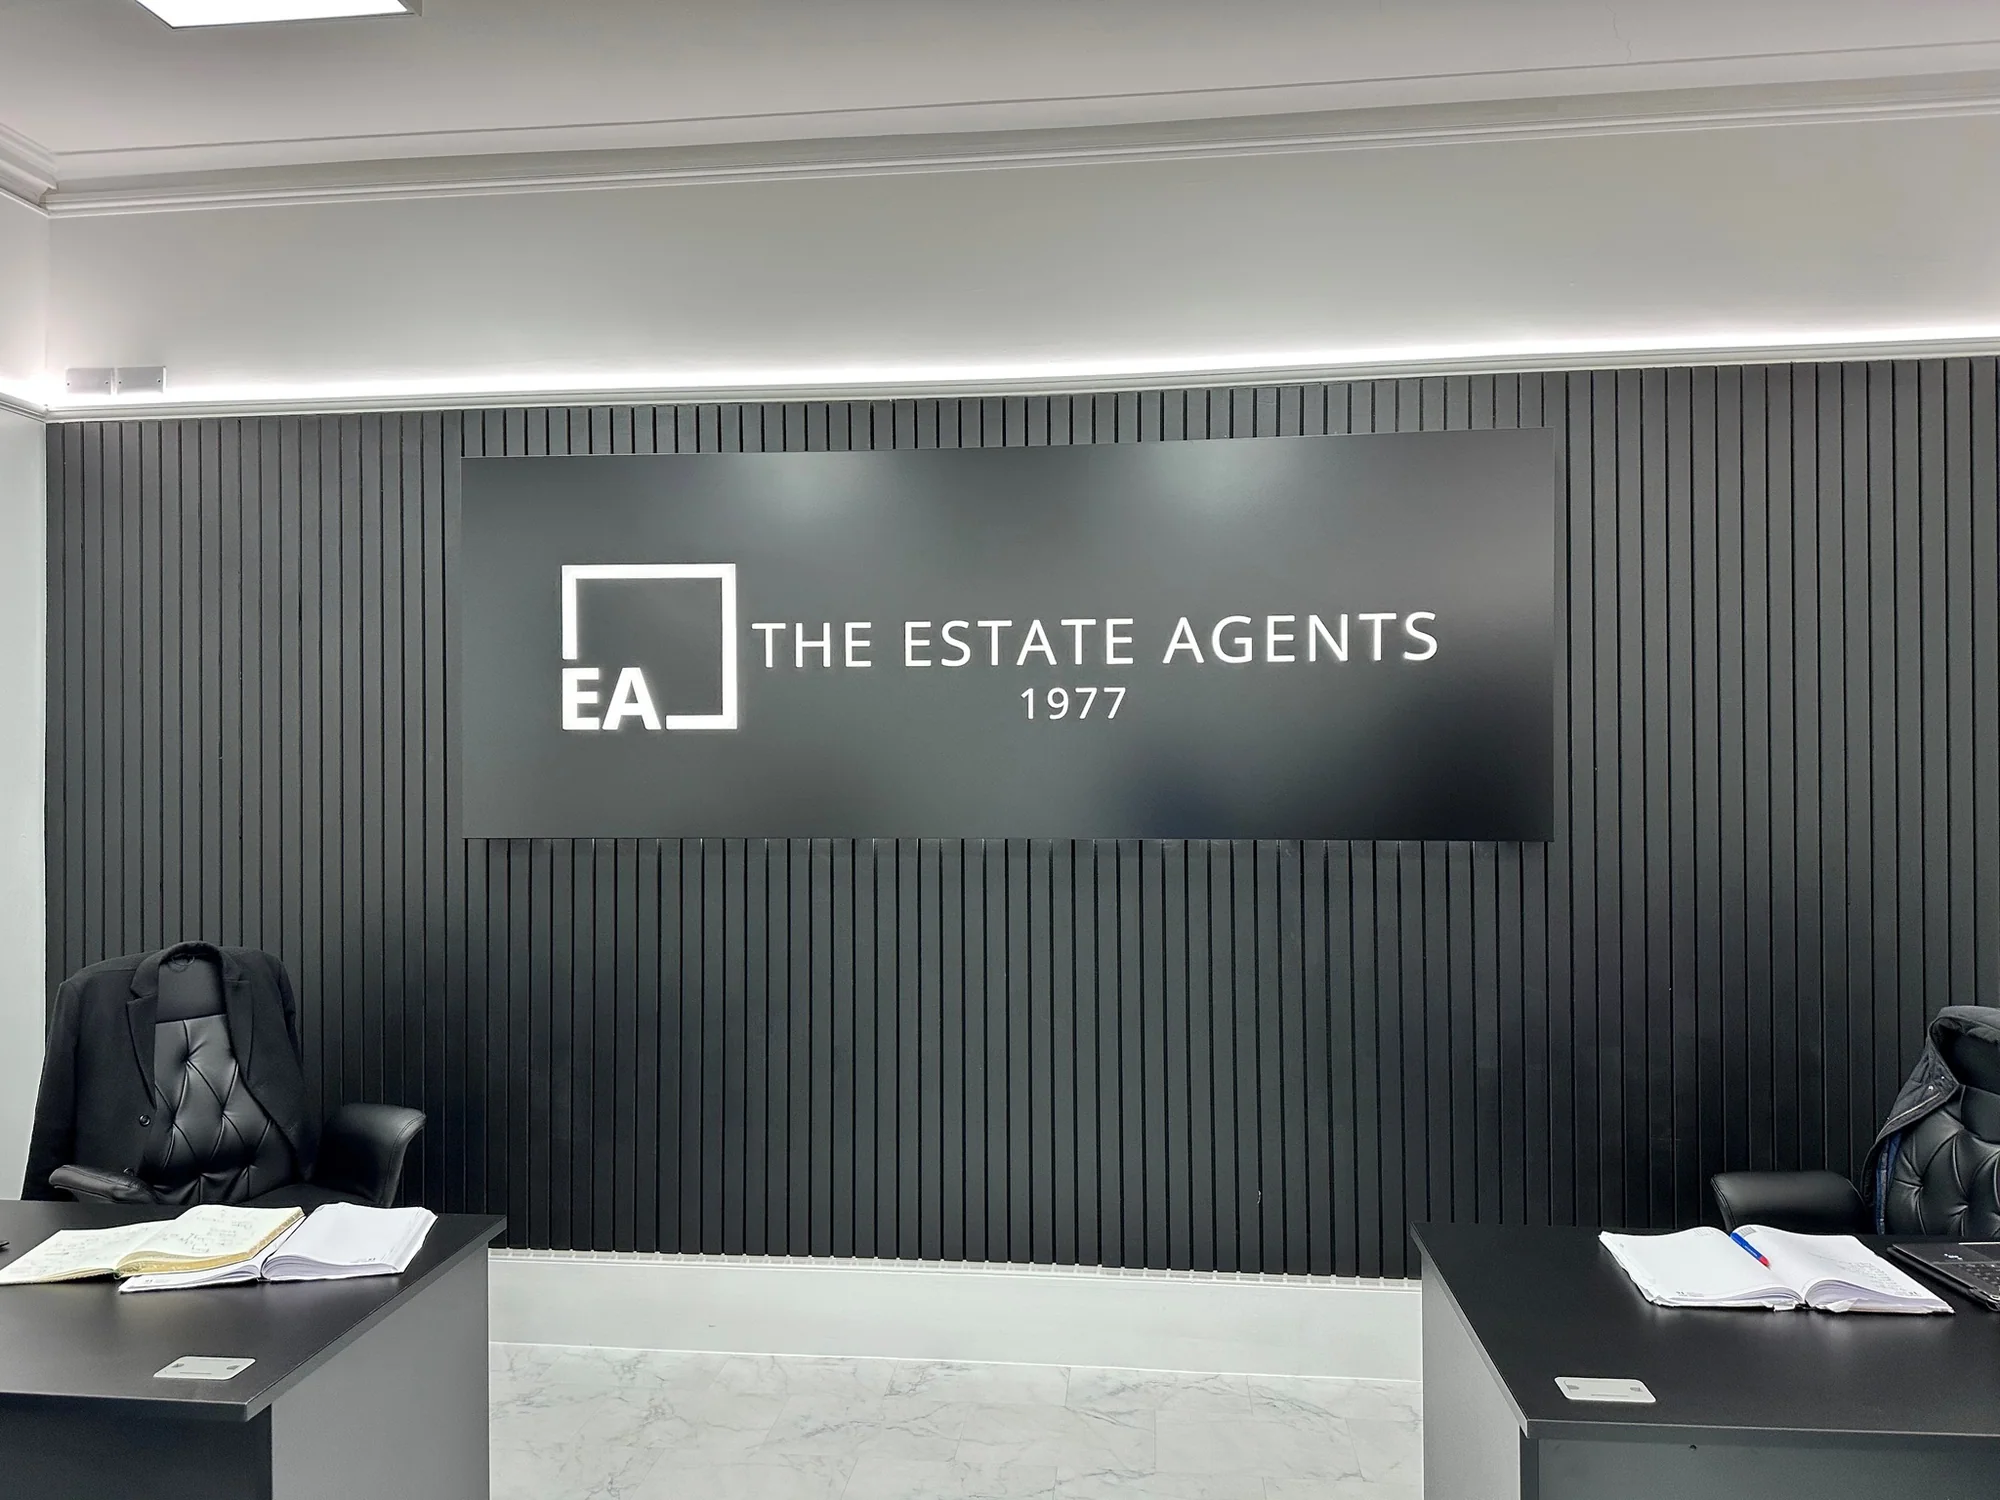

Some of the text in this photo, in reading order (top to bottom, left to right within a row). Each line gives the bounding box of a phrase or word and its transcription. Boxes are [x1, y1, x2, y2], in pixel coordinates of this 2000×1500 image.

[752, 612, 1439, 668] THE ESTATE AGENTS
[562, 667, 662, 731] EA
[1020, 686, 1127, 720] 1977
